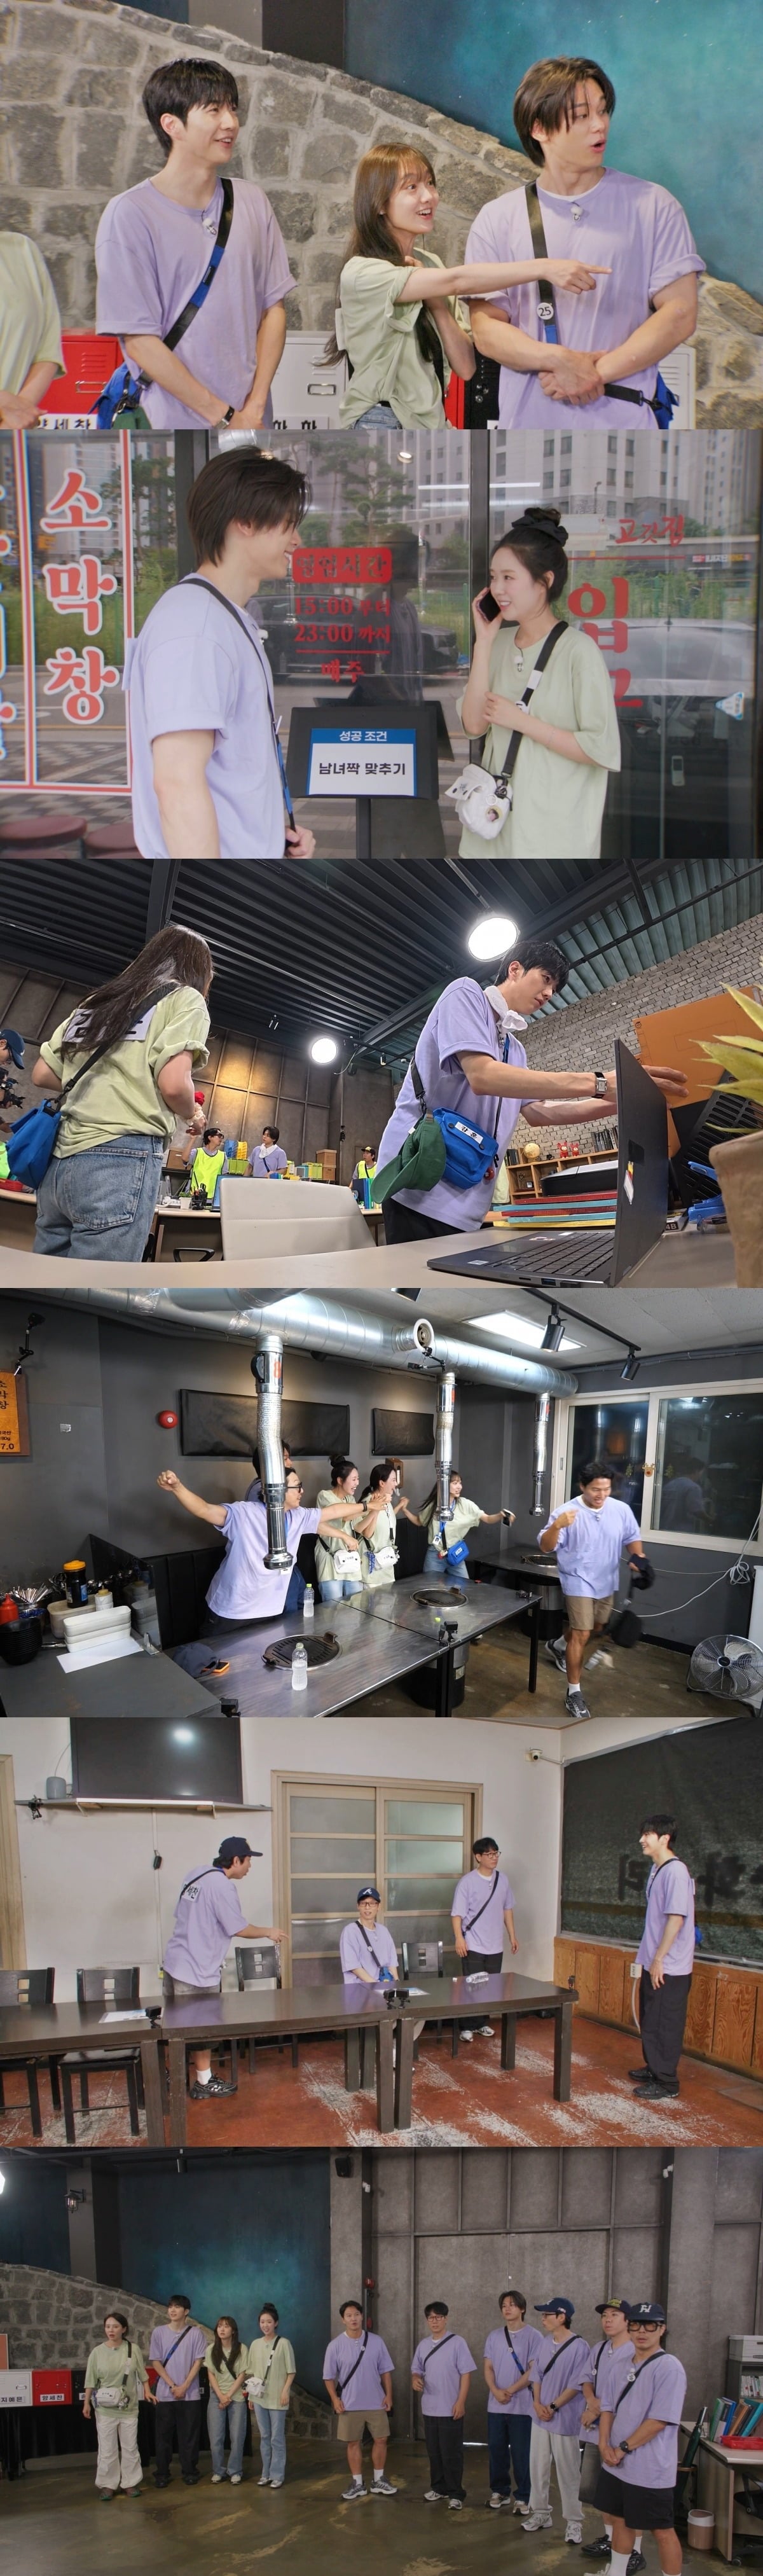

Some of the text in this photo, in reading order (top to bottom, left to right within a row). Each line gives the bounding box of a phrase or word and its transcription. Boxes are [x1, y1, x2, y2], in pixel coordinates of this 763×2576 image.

[539, 307, 551, 316] 25
[296, 554, 387, 578] 영업시간
[42, 470, 119, 723] 소막창
[295, 596, 390, 617] 15:00 부터
[294, 623, 390, 644] 23:00 까지
[321, 658, 364, 683] 매주
[340, 731, 387, 742] 성공 조건
[319, 763, 406, 775] 남녀짝 맞추기
